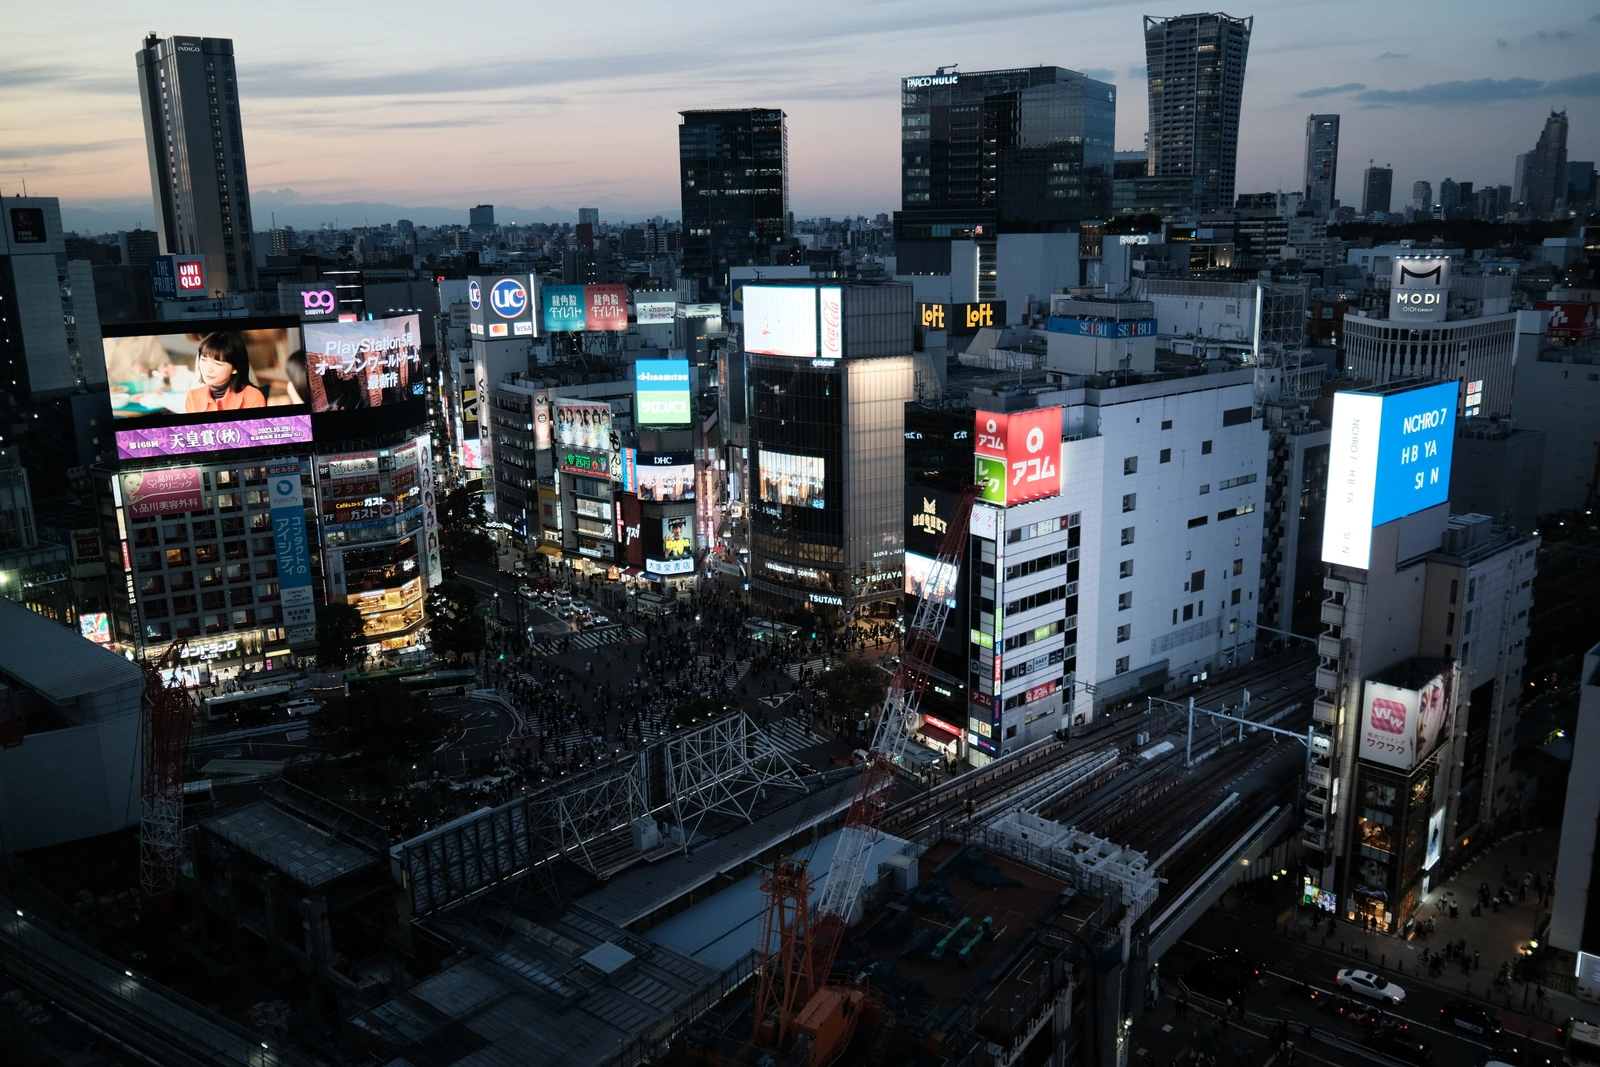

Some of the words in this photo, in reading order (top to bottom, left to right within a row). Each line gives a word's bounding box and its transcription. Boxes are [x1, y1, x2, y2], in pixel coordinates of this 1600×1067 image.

[907, 77, 931, 87] PARCO
[932, 76, 958, 85] HULIC
[156, 261, 169, 276] THE
[179, 265, 198, 276] UNI
[154, 277, 175, 292] PRIME
[181, 276, 201, 288] QLO
[301, 290, 334, 314] 109
[1397, 293, 1440, 304] MODI
[1080, 322, 1107, 337] SEIBU
[1117, 322, 1151, 337] SEIBU
[325, 335, 401, 357] PlayStation
[315, 350, 420, 376] オープンワールドゲーム
[367, 372, 398, 390] 最新作
[638, 372, 688, 381] Hisamitsu
[641, 400, 687, 414] サロンパス
[1403, 410, 1439, 434] NCHRO
[1440, 408, 1447, 425] 7
[169, 428, 241, 450] 天皇賞(秋)
[978, 434, 1004, 450] アコム
[157, 472, 195, 483] 品川スキン
[319, 467, 329, 475] 9F
[1012, 456, 1055, 486] アコム
[158, 481, 192, 490] クリニック
[139, 498, 199, 513] 品川美容外科
[273, 496, 299, 504] eyecity
[364, 496, 386, 507] ガスト
[351, 509, 378, 520] ガスト
[276, 518, 295, 576] アイシティ
[291, 516, 307, 574] コンタクトの
[76, 556, 104, 565] ESPACE
[36, 572, 68, 582] CITY
[866, 571, 902, 583] TSUTAYA
[809, 594, 843, 606] TSUTAYA
[973, 692, 992, 706] アコム
[1367, 738, 1406, 755] ワクワク
